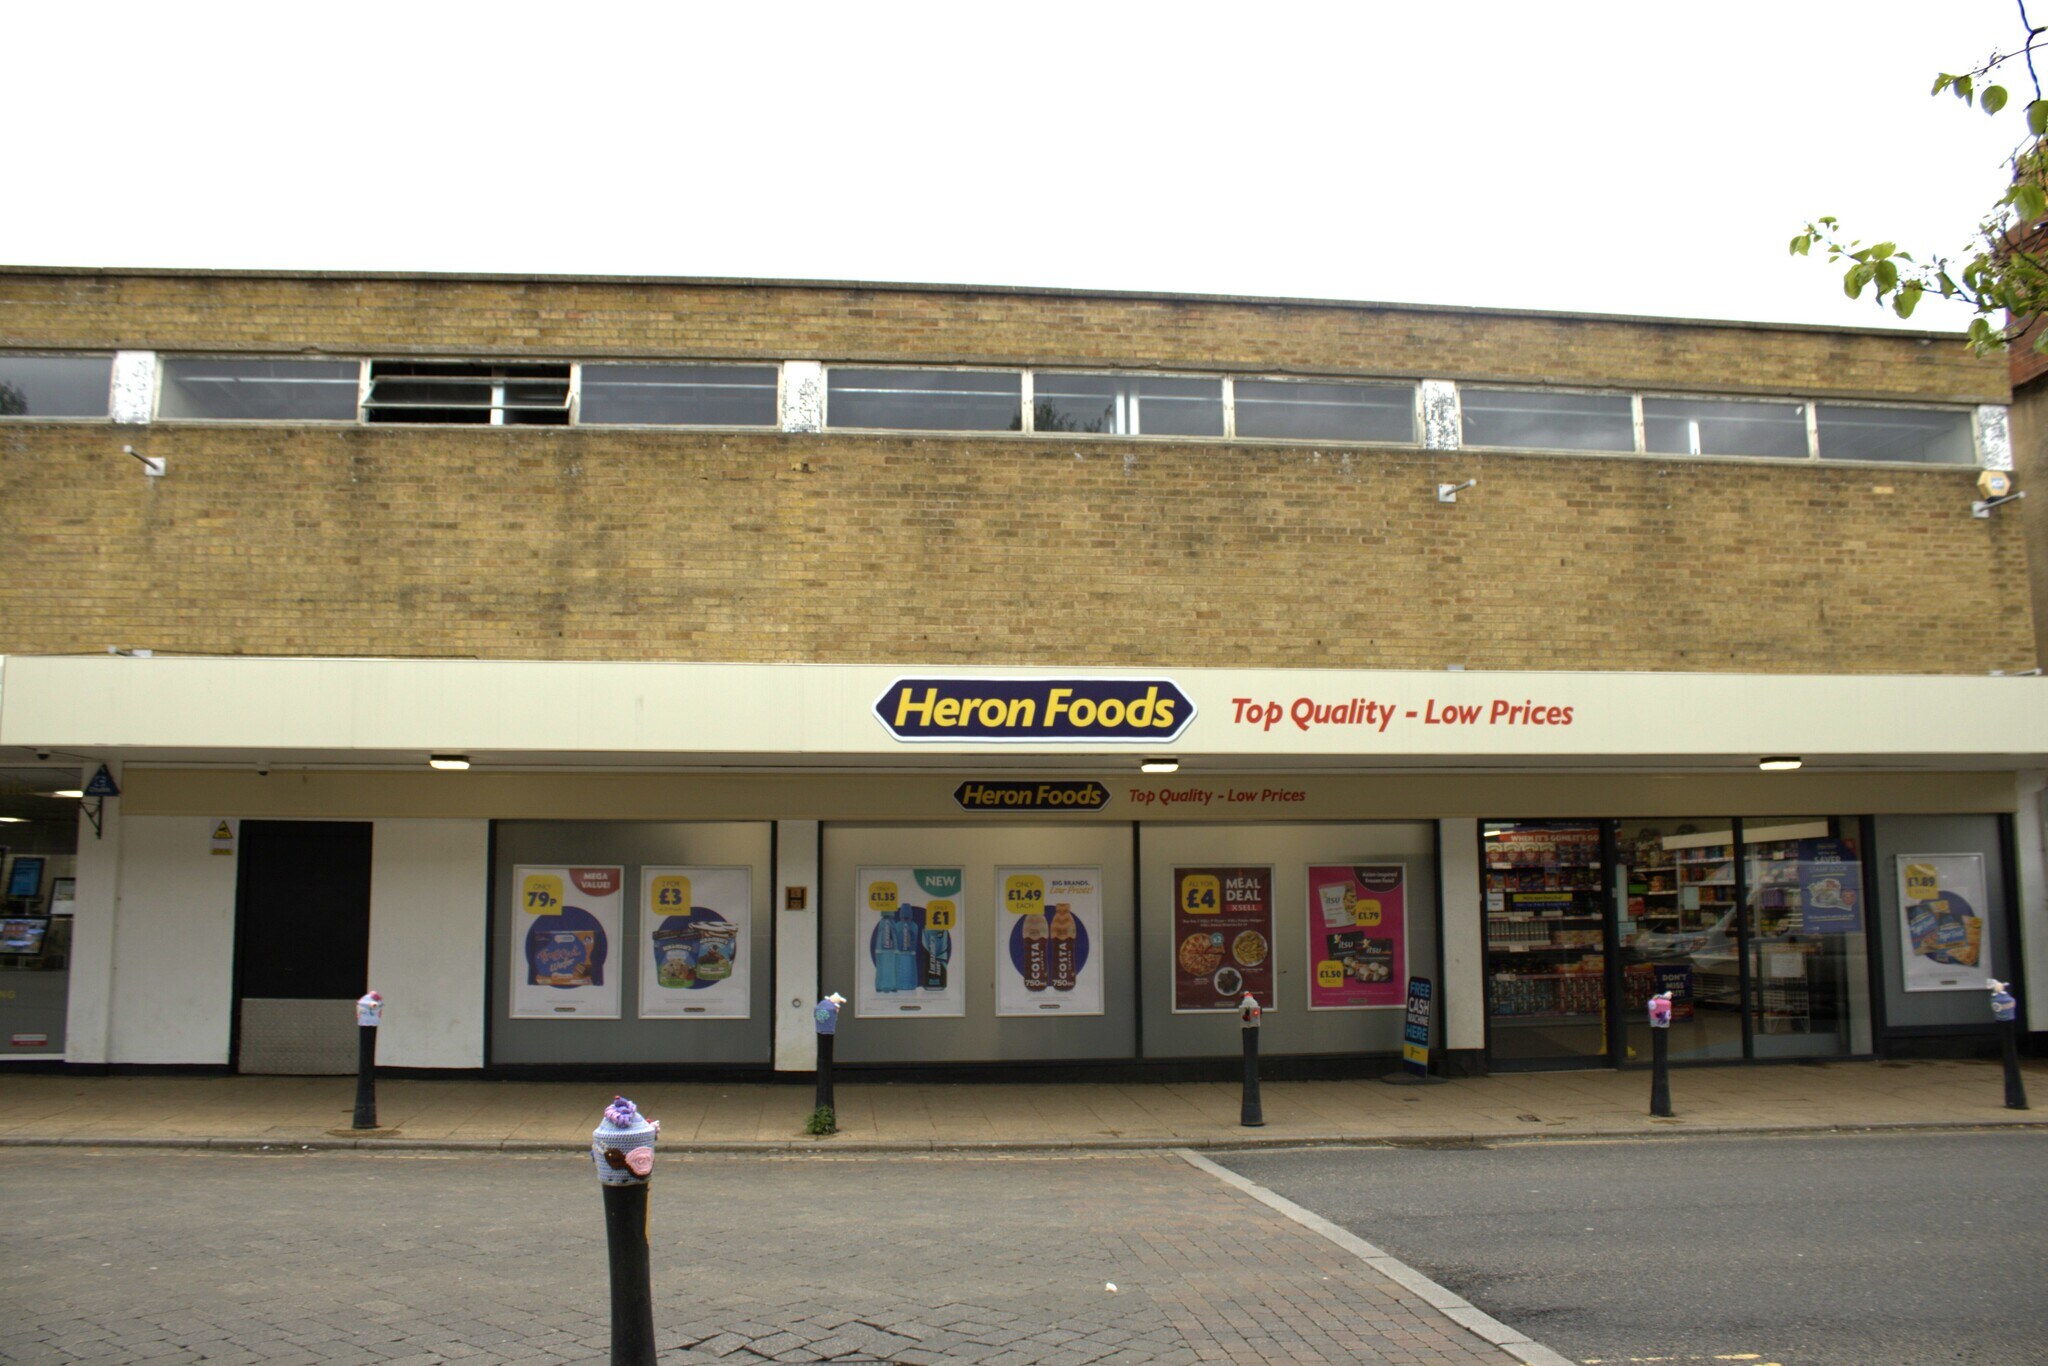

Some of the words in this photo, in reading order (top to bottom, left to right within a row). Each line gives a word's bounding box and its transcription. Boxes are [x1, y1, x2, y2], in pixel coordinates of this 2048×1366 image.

[894, 688, 1036, 727] Heron
[1043, 686, 1175, 728] Foods
[1232, 698, 1283, 731] Top
[1290, 698, 1396, 732] Quality
[1405, 710, 1418, 718] -
[1425, 699, 1483, 725] Low
[1490, 699, 1574, 725] Prices
[963, 785, 1033, 805] Heron
[1036, 785, 1102, 805] Foods
[1130, 788, 1155, 805] Top
[1159, 788, 1212, 806] Quality
[1228, 789, 1257, 802] Low
[1261, 789, 1306, 802] Prices
[1511, 834, 1533, 842] WHEN
[583, 872, 608, 880] MEGA
[925, 876, 956, 887] NEW
[581, 881, 611, 889] VALUE!
[1226, 878, 1261, 889] MEAL
[659, 888, 683, 905] £3
[871, 892, 895, 901] £1.35
[1008, 890, 1042, 901] £1.49
[1187, 889, 1215, 908] £4
[1226, 890, 1261, 901] DEAL
[1325, 896, 1340, 904] itsu
[932, 911, 949, 925] £1
[1358, 912, 1379, 920] £1.79
[1338, 940, 1354, 949] itsu
[1366, 945, 1381, 953] itsu
[1031, 942, 1040, 979] COSTA
[1059, 942, 1067, 979] COSTA
[1320, 970, 1342, 978] £1.50
[1409, 981, 1430, 998] FREE
[1408, 997, 1430, 1016] CASH
[1407, 1013, 1429, 1027] MACHINE
[1406, 1025, 1428, 1042] HERE
